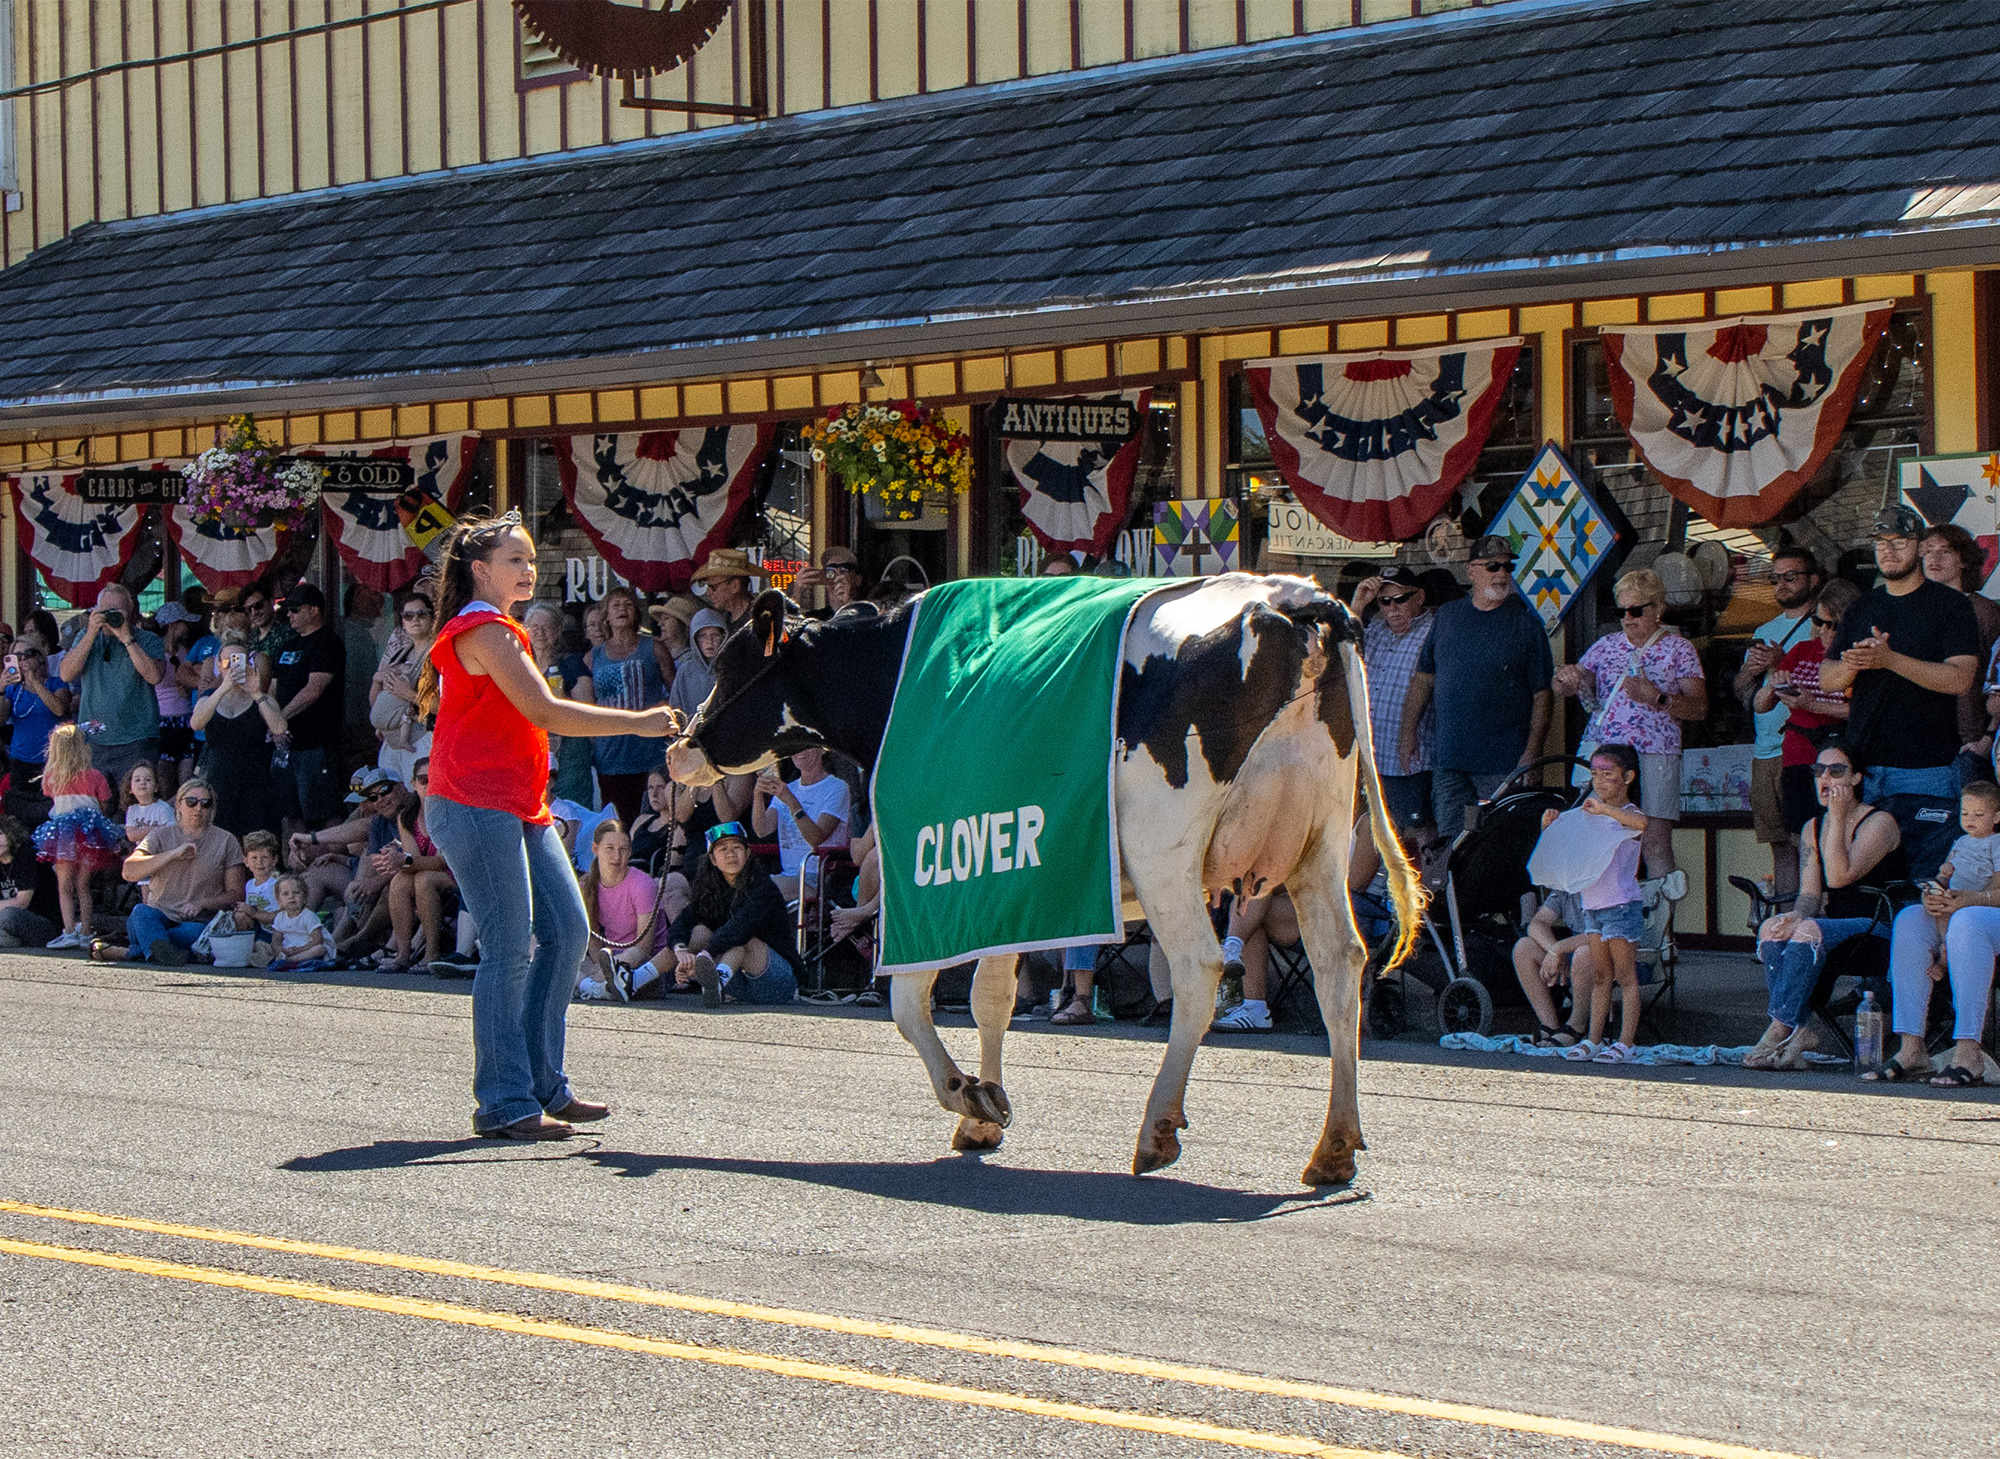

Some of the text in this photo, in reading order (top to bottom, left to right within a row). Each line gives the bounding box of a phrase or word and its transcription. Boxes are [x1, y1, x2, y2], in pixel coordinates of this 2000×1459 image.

[1002, 403, 1129, 435] ANTIQUES
[337, 466, 400, 484] & OLD
[88, 478, 134, 498] CARDS
[162, 478, 184, 497] GIF
[763, 559, 807, 572] WELCO
[914, 805, 1045, 887] CLOVER
